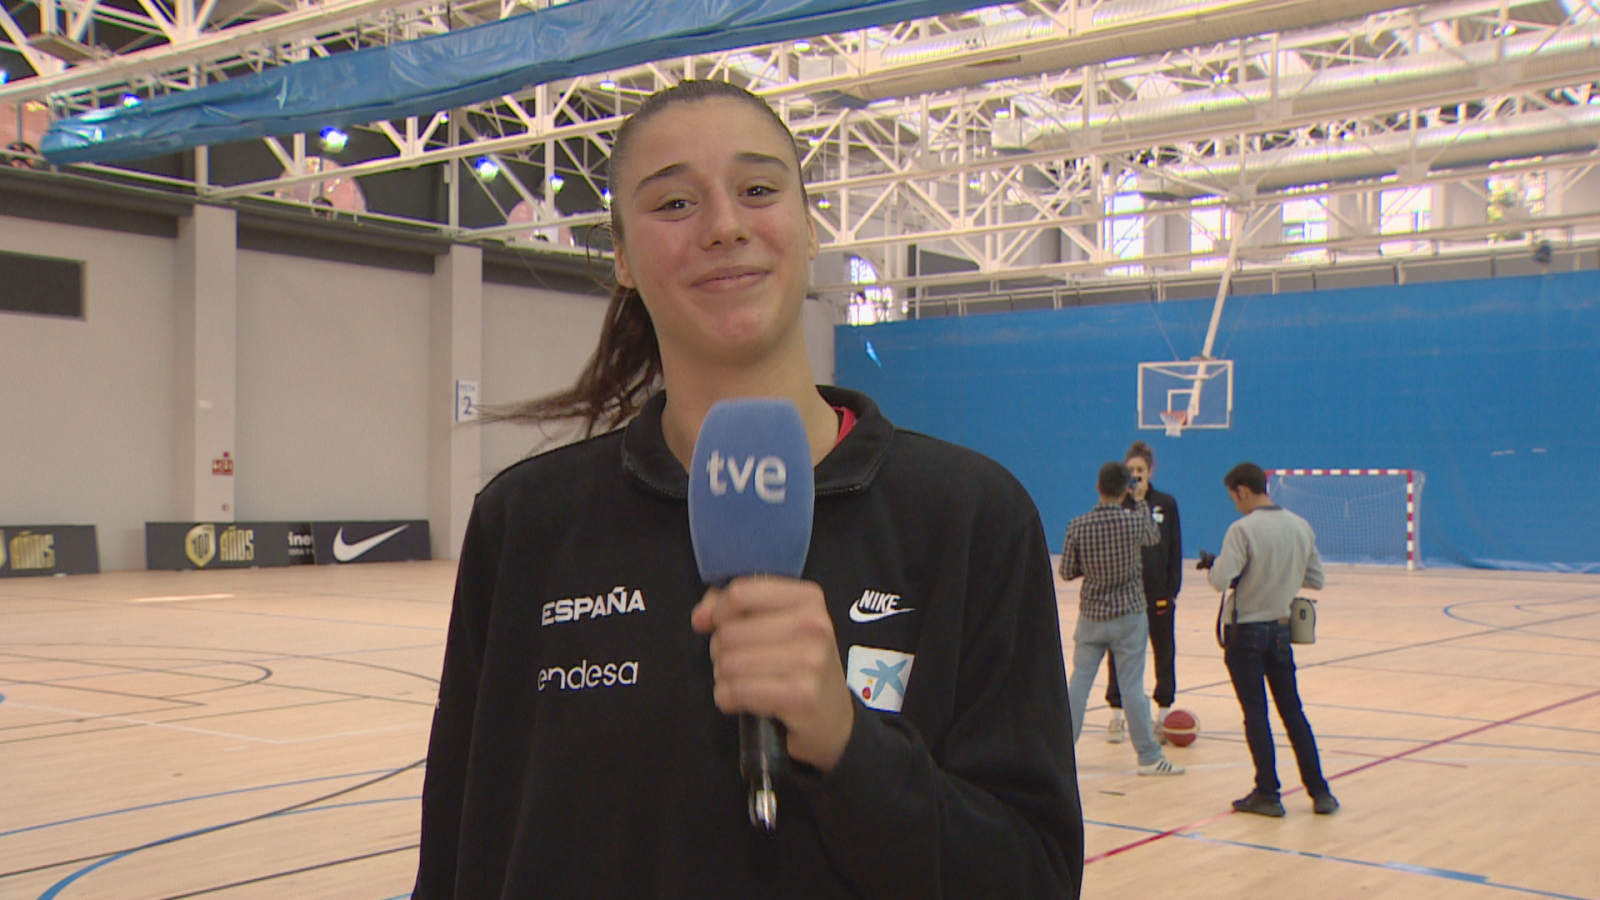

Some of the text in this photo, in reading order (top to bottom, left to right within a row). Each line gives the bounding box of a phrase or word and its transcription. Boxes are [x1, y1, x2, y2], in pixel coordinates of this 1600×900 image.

[463, 395, 473, 415] 2
[706, 450, 787, 504] tve
[219, 525, 254, 561] AÑOS
[287, 528, 313, 546] ine
[541, 586, 646, 626] ESPAÑA
[859, 589, 901, 613] NIKE
[538, 660, 639, 691] endesa
